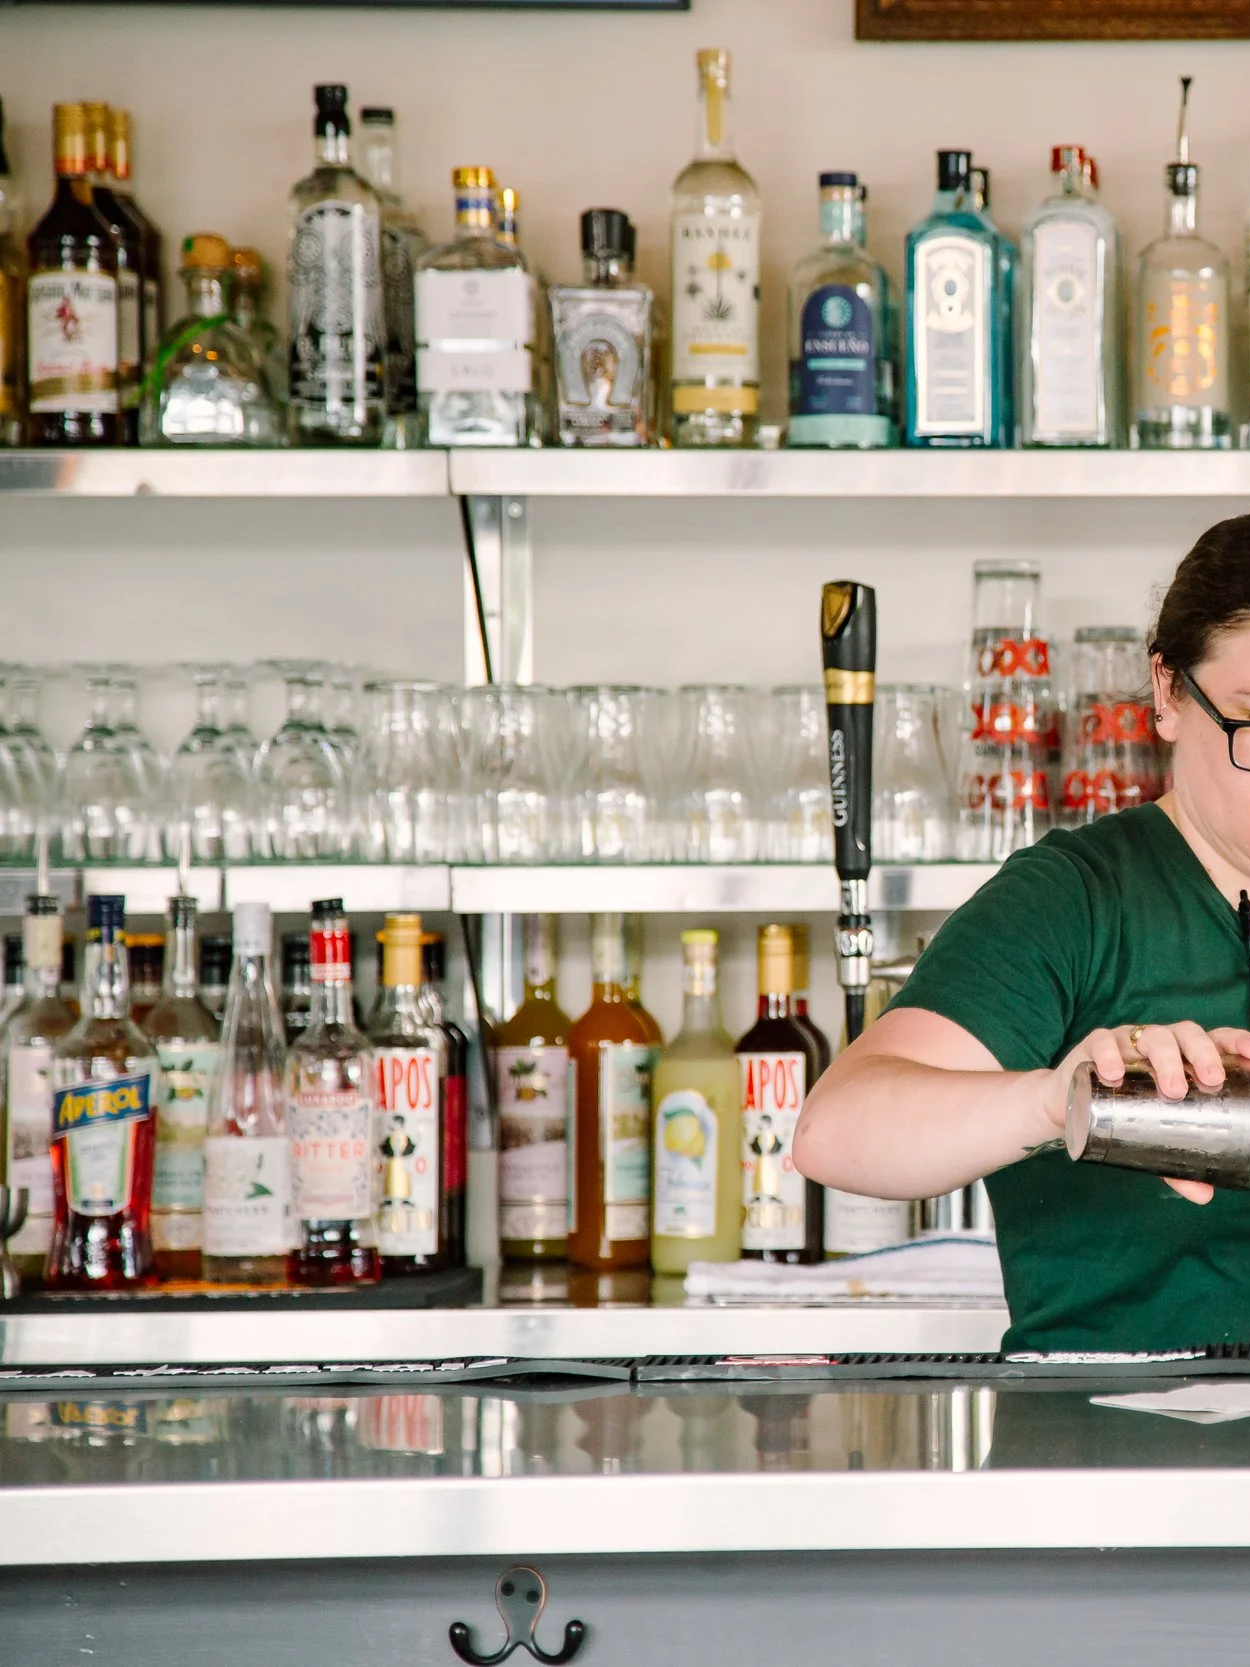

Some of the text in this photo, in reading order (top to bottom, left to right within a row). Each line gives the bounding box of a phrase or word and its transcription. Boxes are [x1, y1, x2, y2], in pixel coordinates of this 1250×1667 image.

[830, 728, 848, 827] GUINNESS
[57, 1086, 142, 1127] APEROL
[376, 1056, 432, 1112] APOS
[742, 1058, 798, 1112] APOS
[291, 1141, 367, 1161] BITTER
